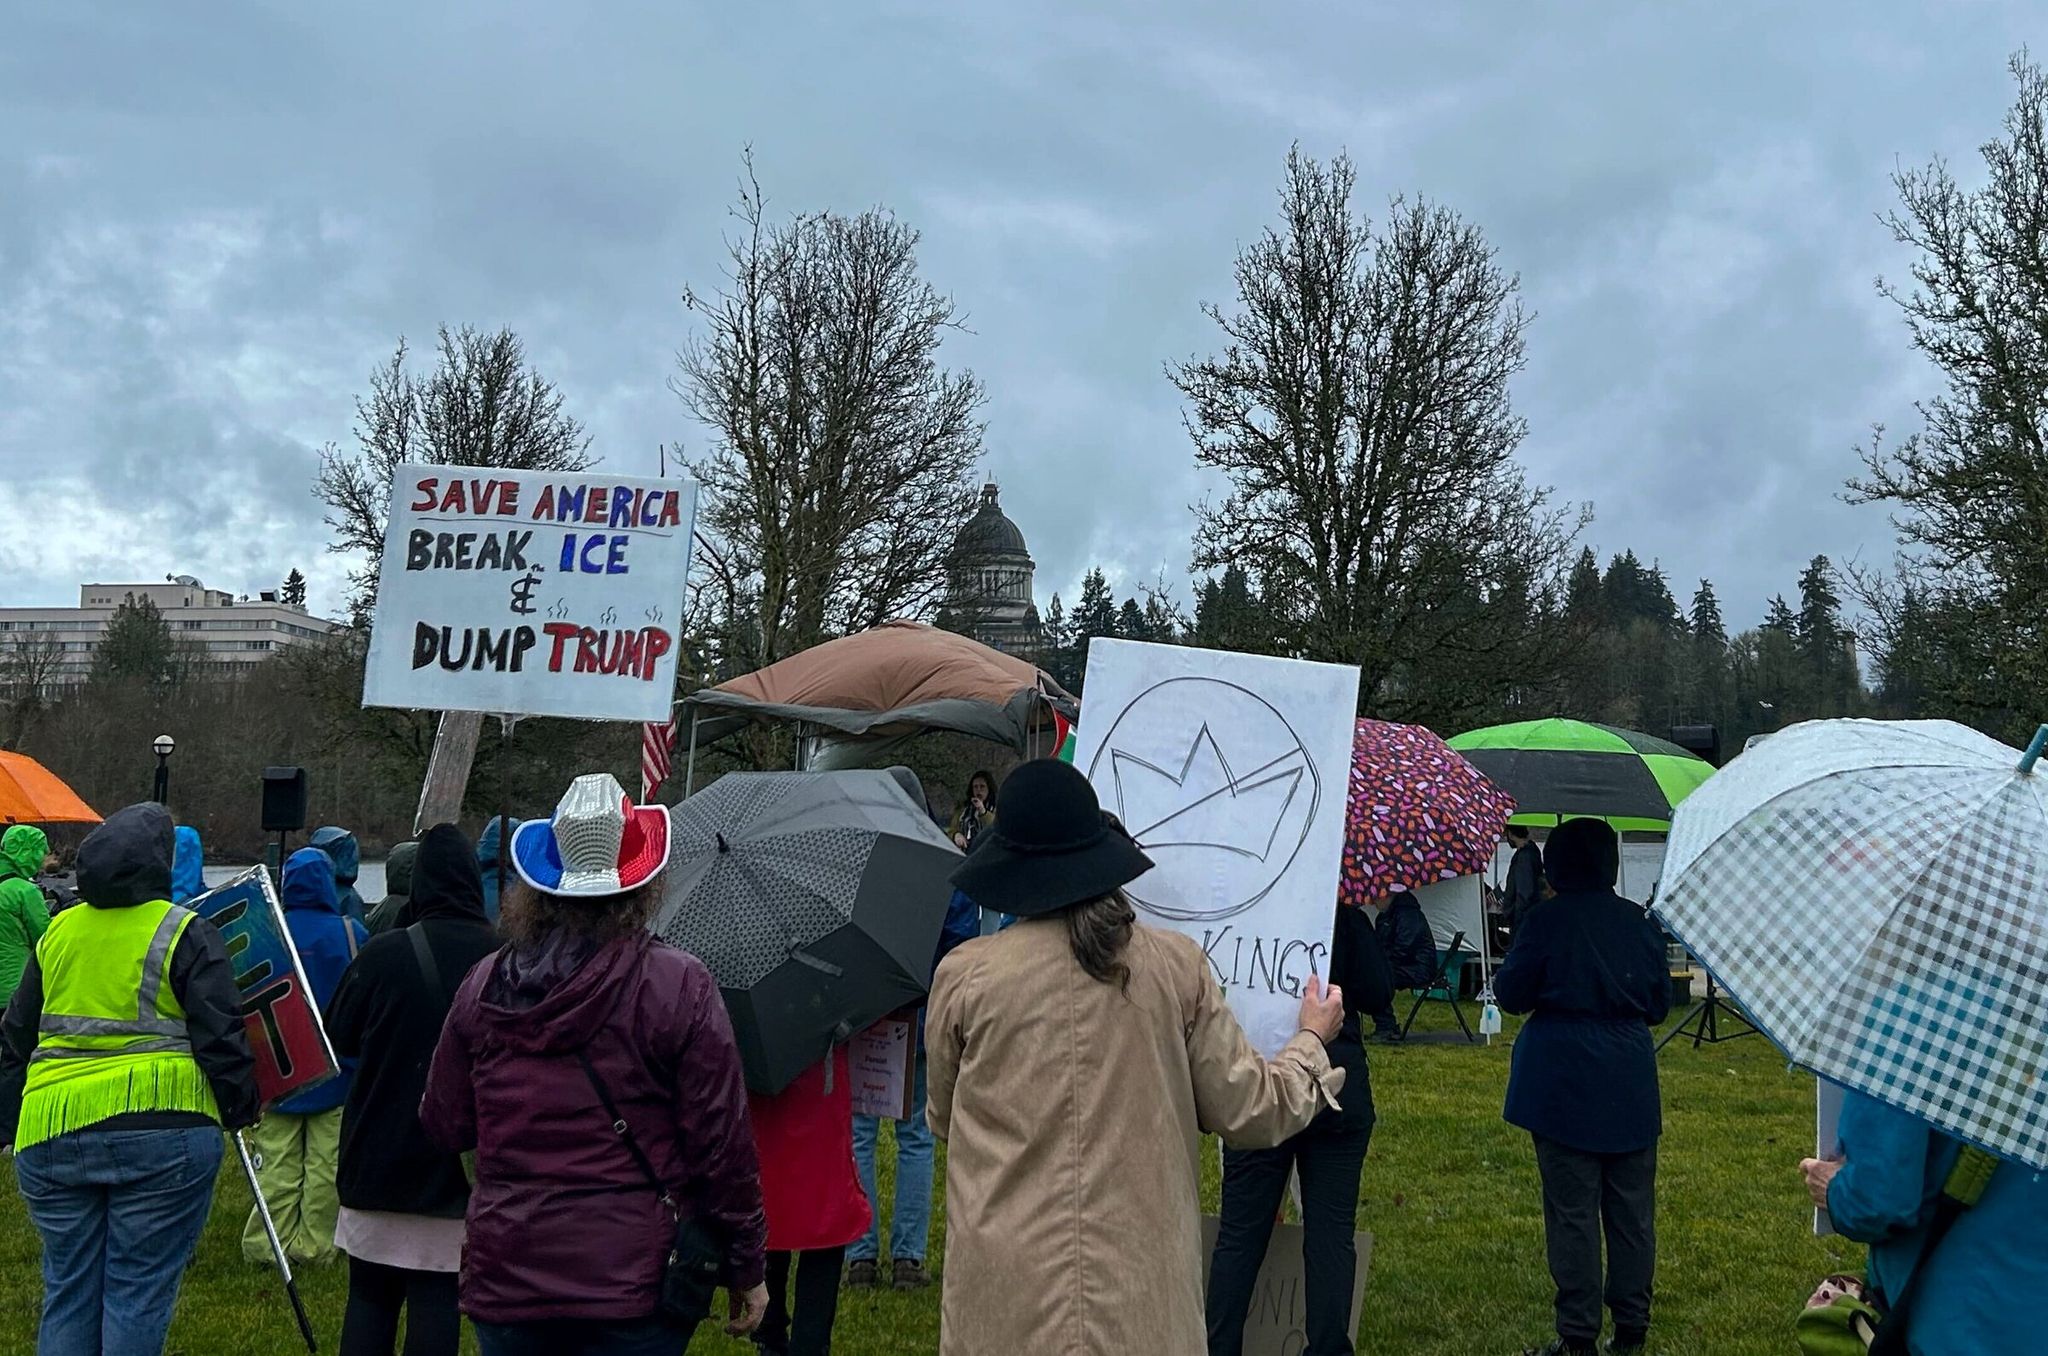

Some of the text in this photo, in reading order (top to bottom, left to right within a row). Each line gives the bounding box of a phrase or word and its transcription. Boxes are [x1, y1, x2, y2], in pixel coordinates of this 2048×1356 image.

[411, 477, 681, 528] SAVE AMERICA
[406, 528, 534, 571] BREAK
[559, 532, 630, 575] ICE
[510, 572, 542, 616] &
[412, 620, 672, 681] DUMP TRUMP
